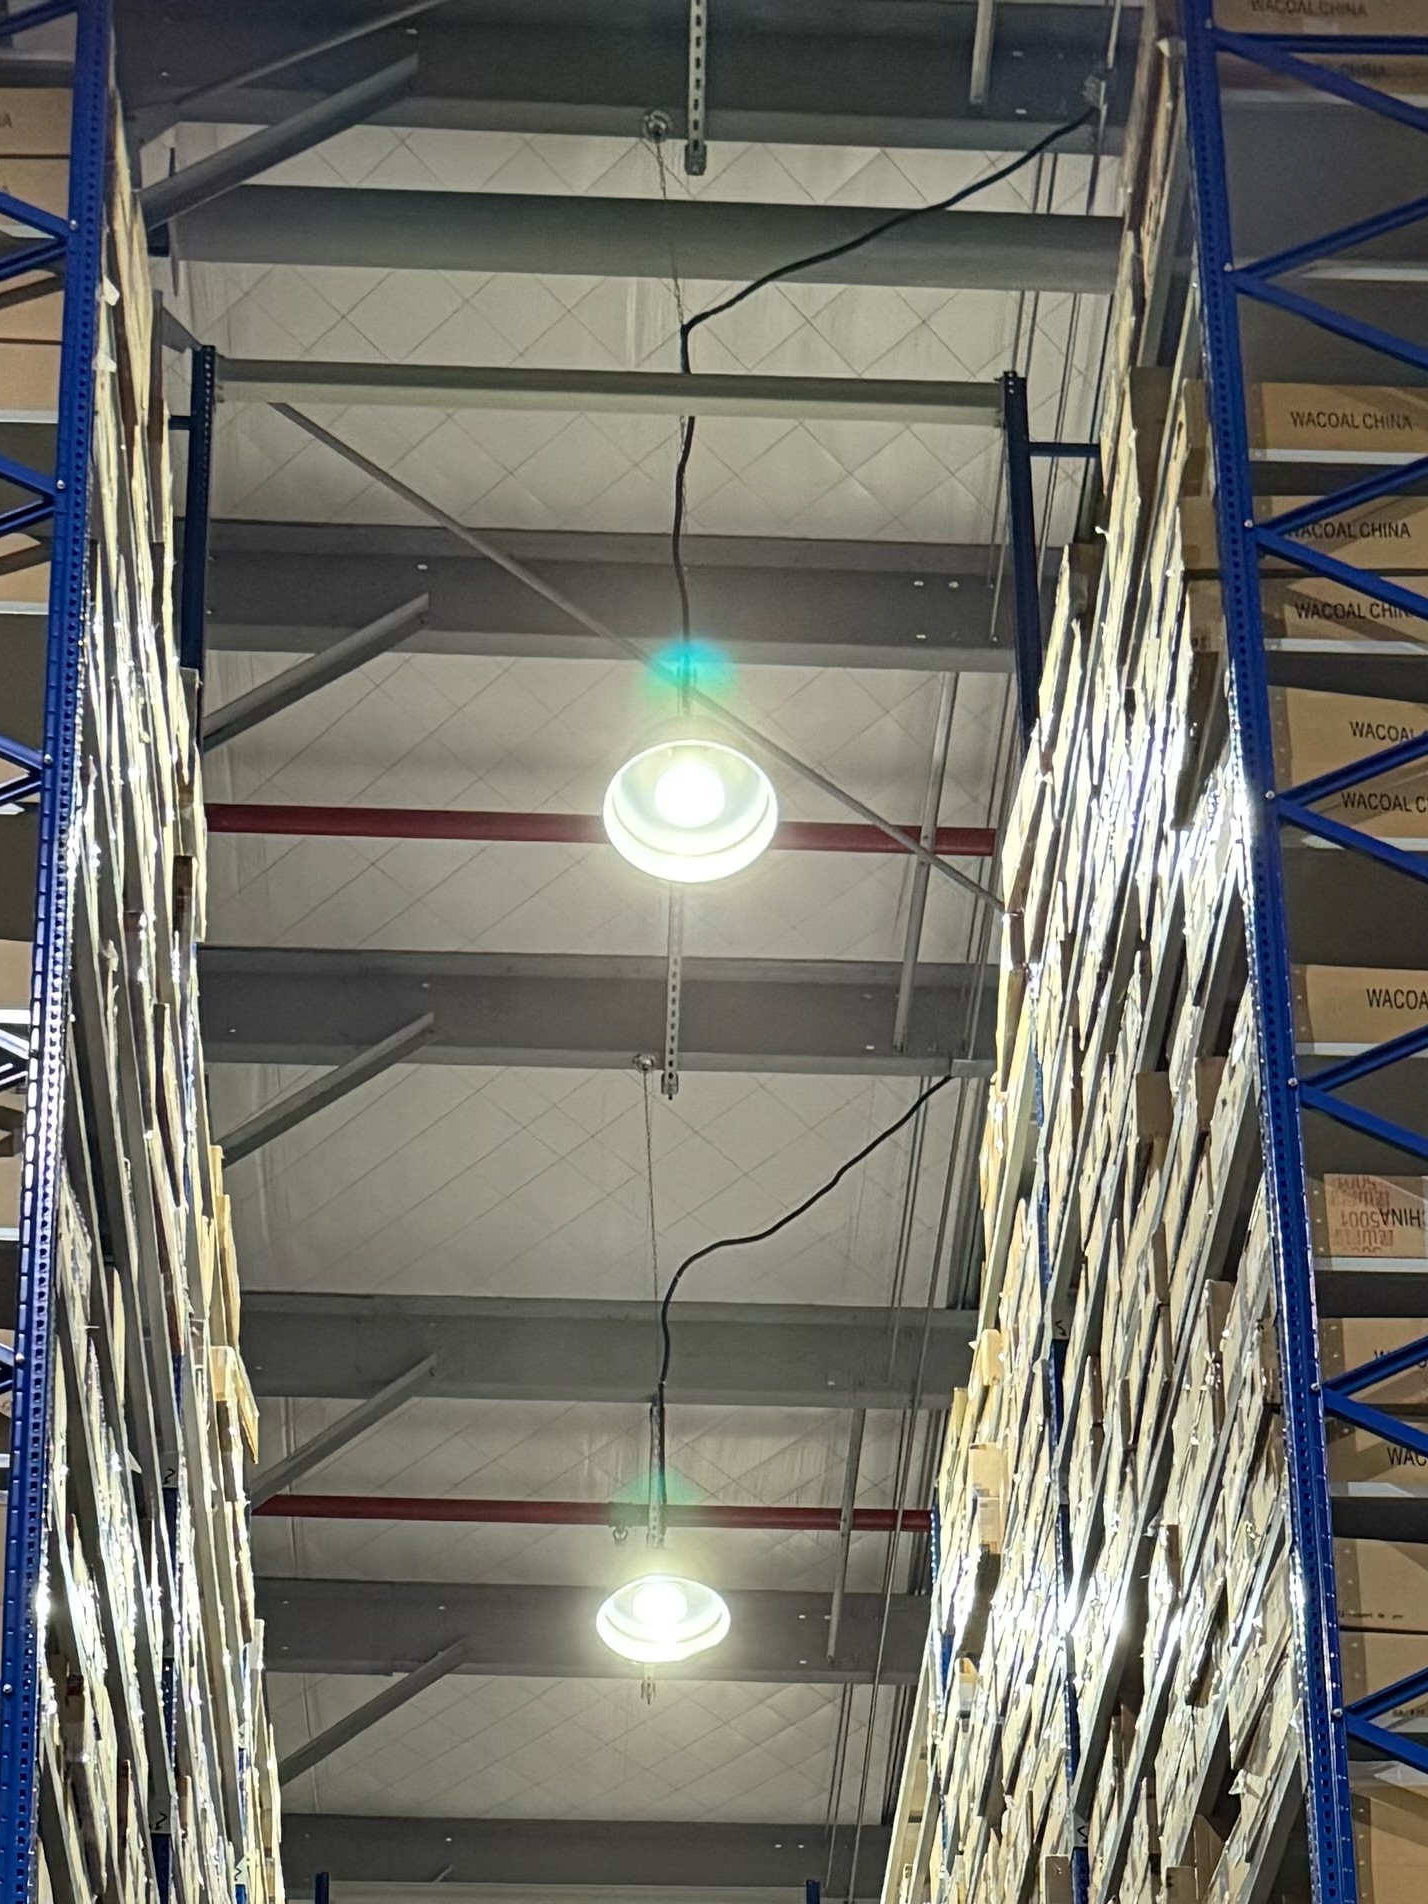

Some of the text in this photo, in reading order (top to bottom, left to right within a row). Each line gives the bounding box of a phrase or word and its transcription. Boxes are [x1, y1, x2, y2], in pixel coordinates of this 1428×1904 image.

[1291, 410, 1413, 431] WACOAL CHINA
[1357, 520, 1410, 539] CHINA
[1295, 602, 1366, 619] WACOAL
[1342, 792, 1412, 813] WACOAL
